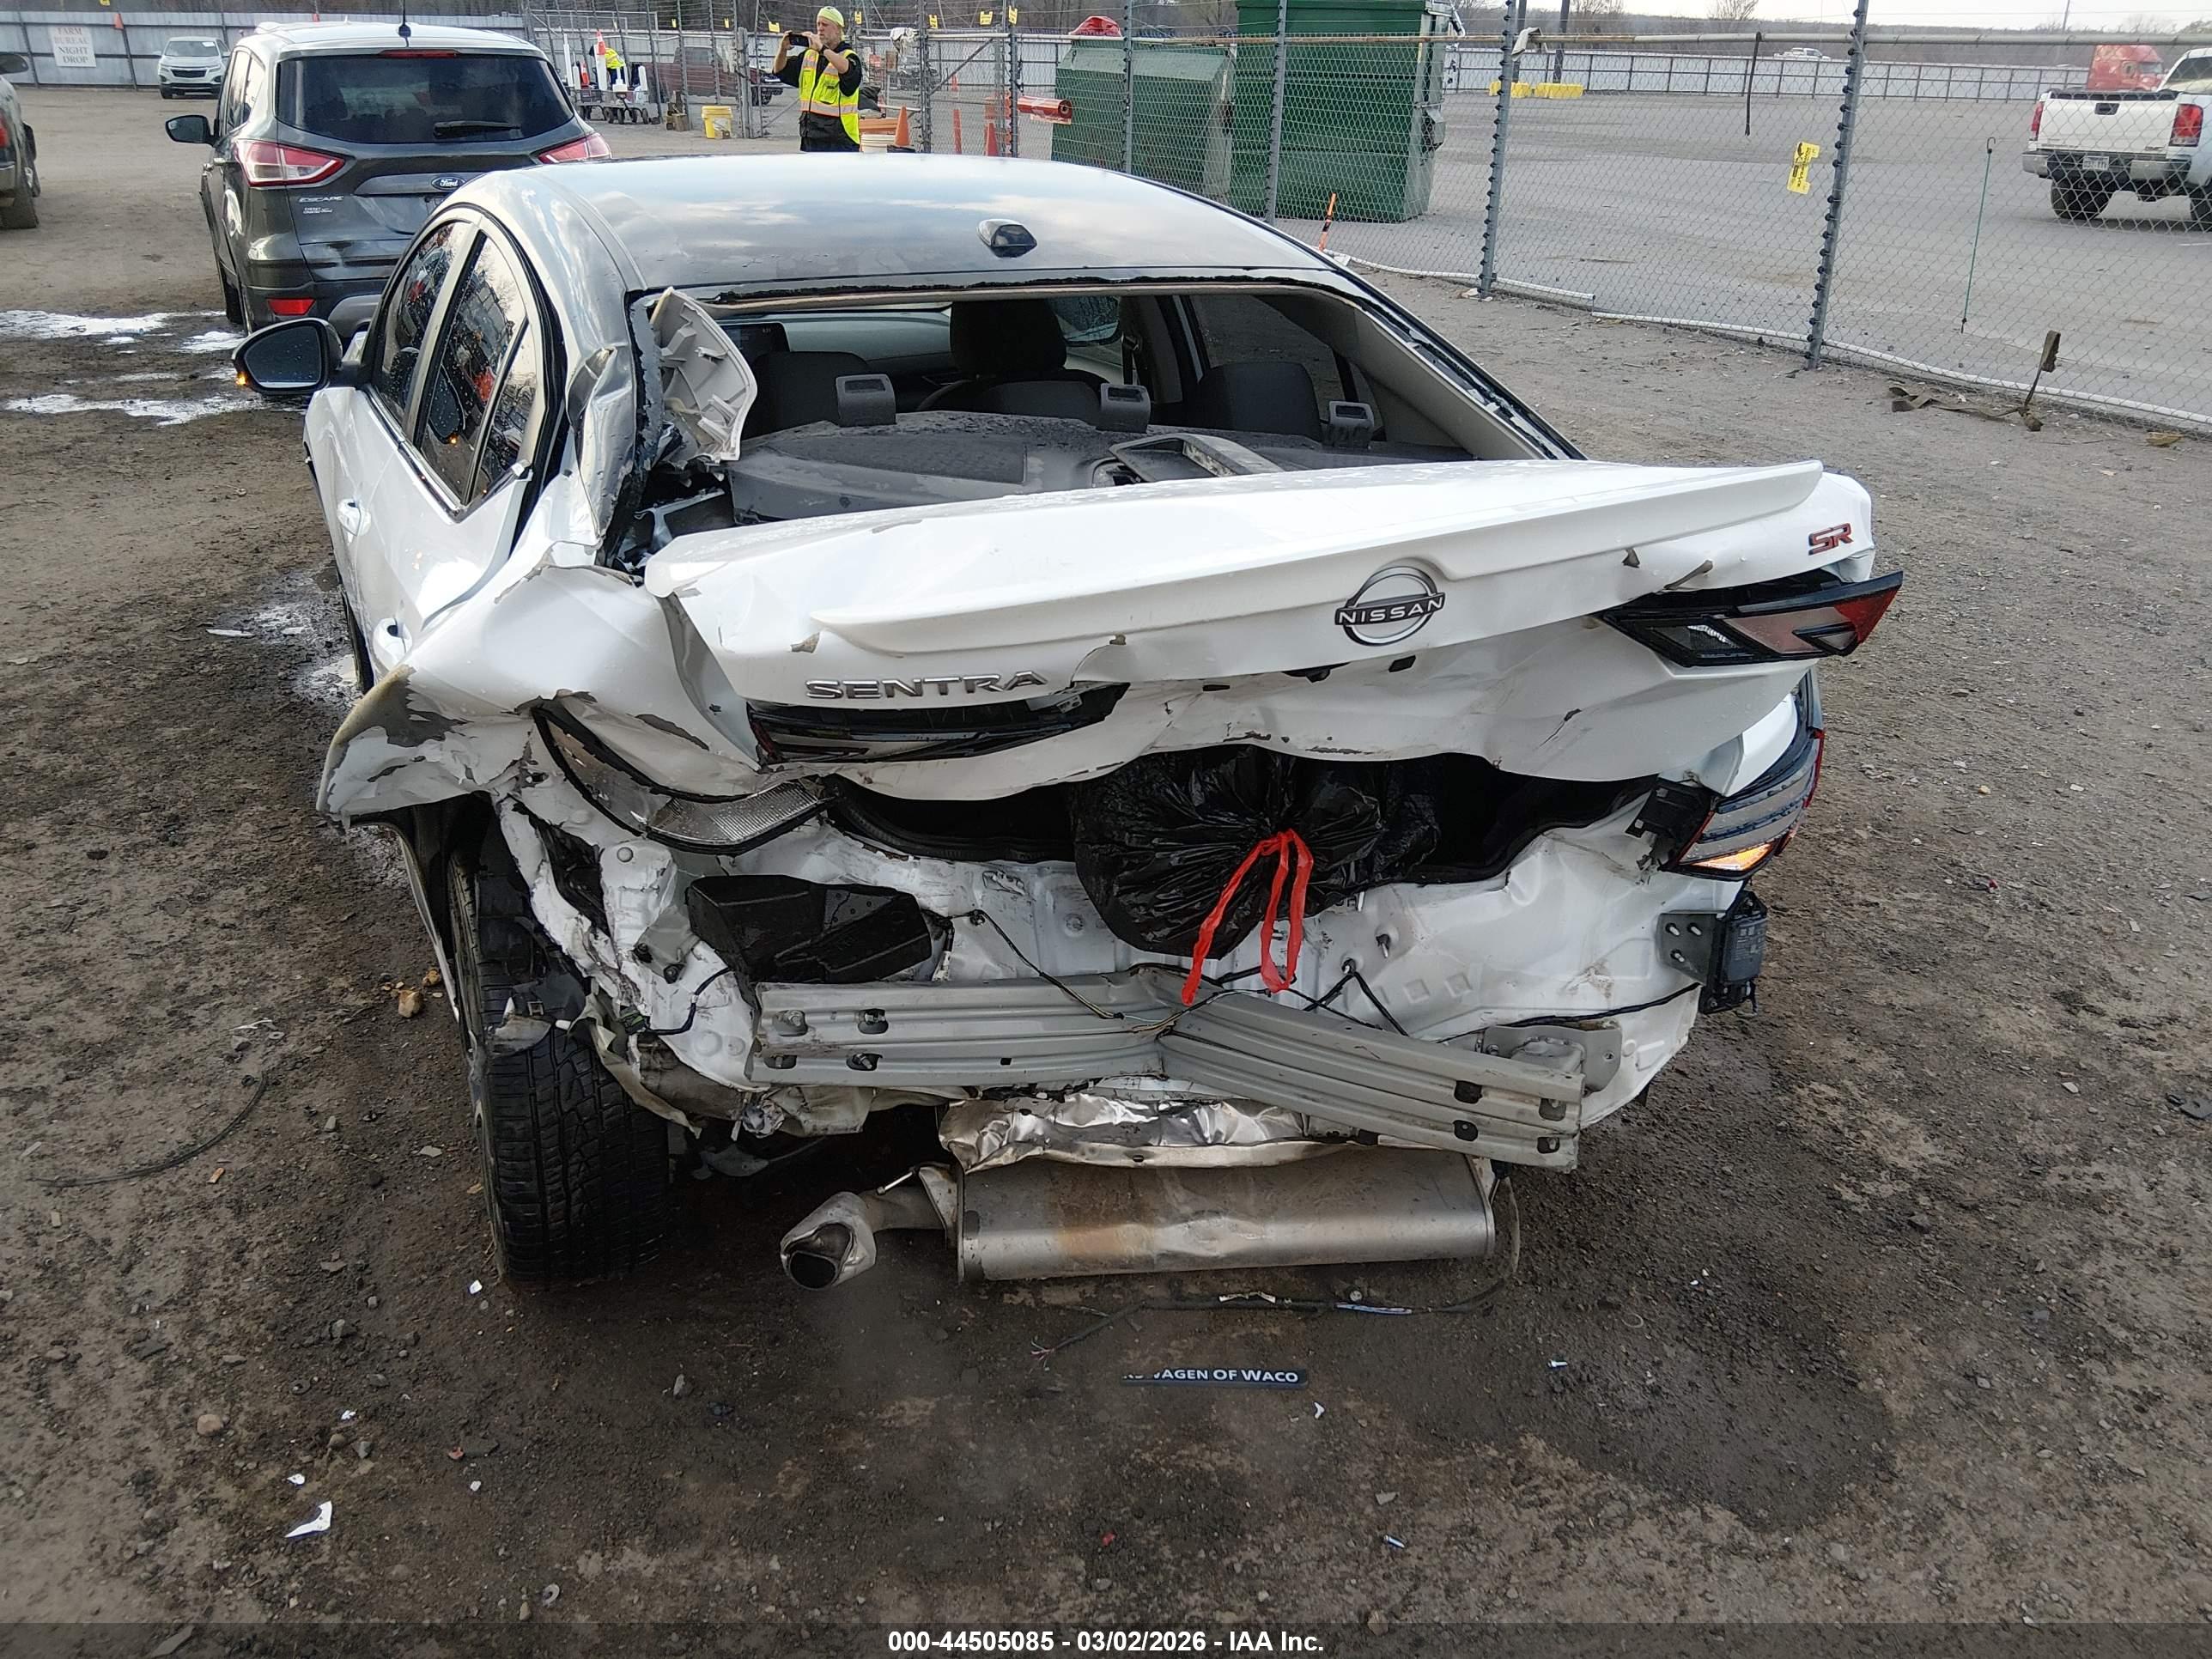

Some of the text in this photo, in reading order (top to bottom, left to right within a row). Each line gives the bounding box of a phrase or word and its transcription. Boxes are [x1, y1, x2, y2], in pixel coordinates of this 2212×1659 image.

[56, 27, 83, 35] FARM
[439, 178, 459, 187] Ford
[1808, 523, 1854, 556] SR
[1338, 596, 1443, 623] NISSAN
[805, 671, 1048, 699] SENTRA
[1212, 1369, 1237, 1381] OF
[1240, 1369, 1299, 1382] WACO
